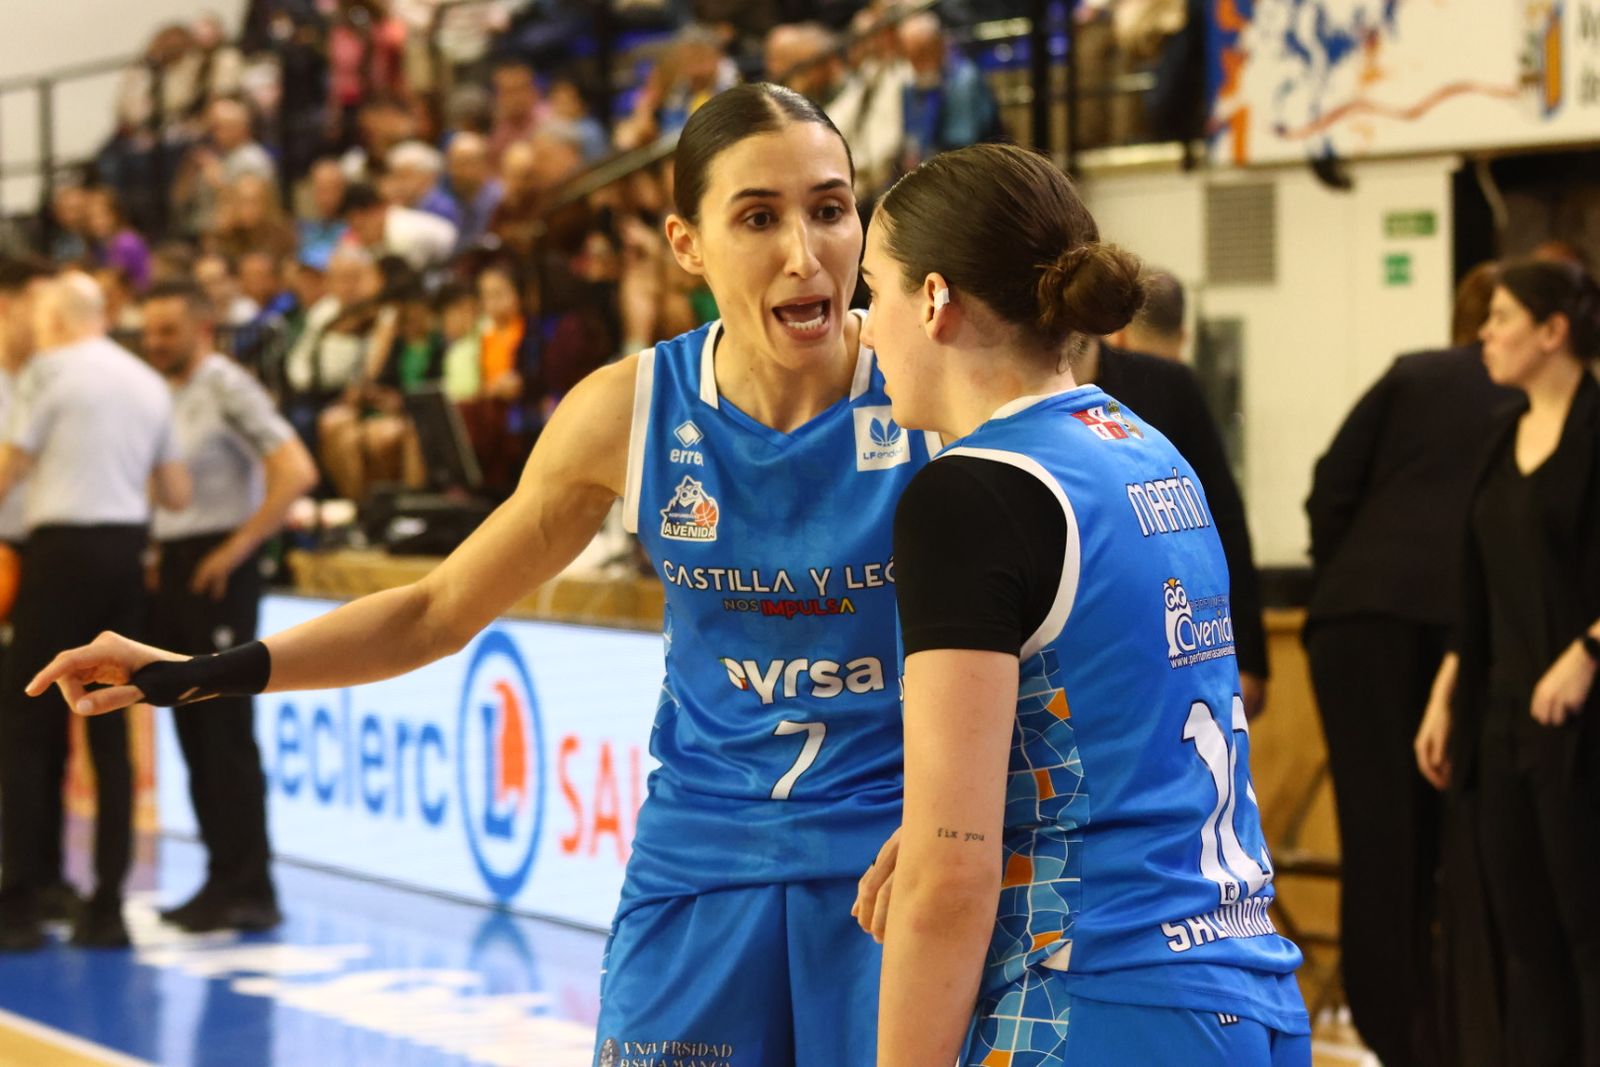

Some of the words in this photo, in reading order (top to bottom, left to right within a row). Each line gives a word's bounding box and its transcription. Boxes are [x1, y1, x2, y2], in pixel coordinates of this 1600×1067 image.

[664, 522, 715, 539] AVENIDA
[662, 559, 795, 593] CASTILLA
[809, 568, 831, 597] Y
[845, 555, 895, 589] LEÓ
[724, 599, 759, 611] NOS
[762, 598, 856, 619] IMPULSA
[266, 686, 448, 828] eclerc
[770, 720, 827, 800] 7
[937, 827, 957, 838] fix
[964, 831, 984, 841] you
[1161, 896, 1277, 953] SALAMANC
